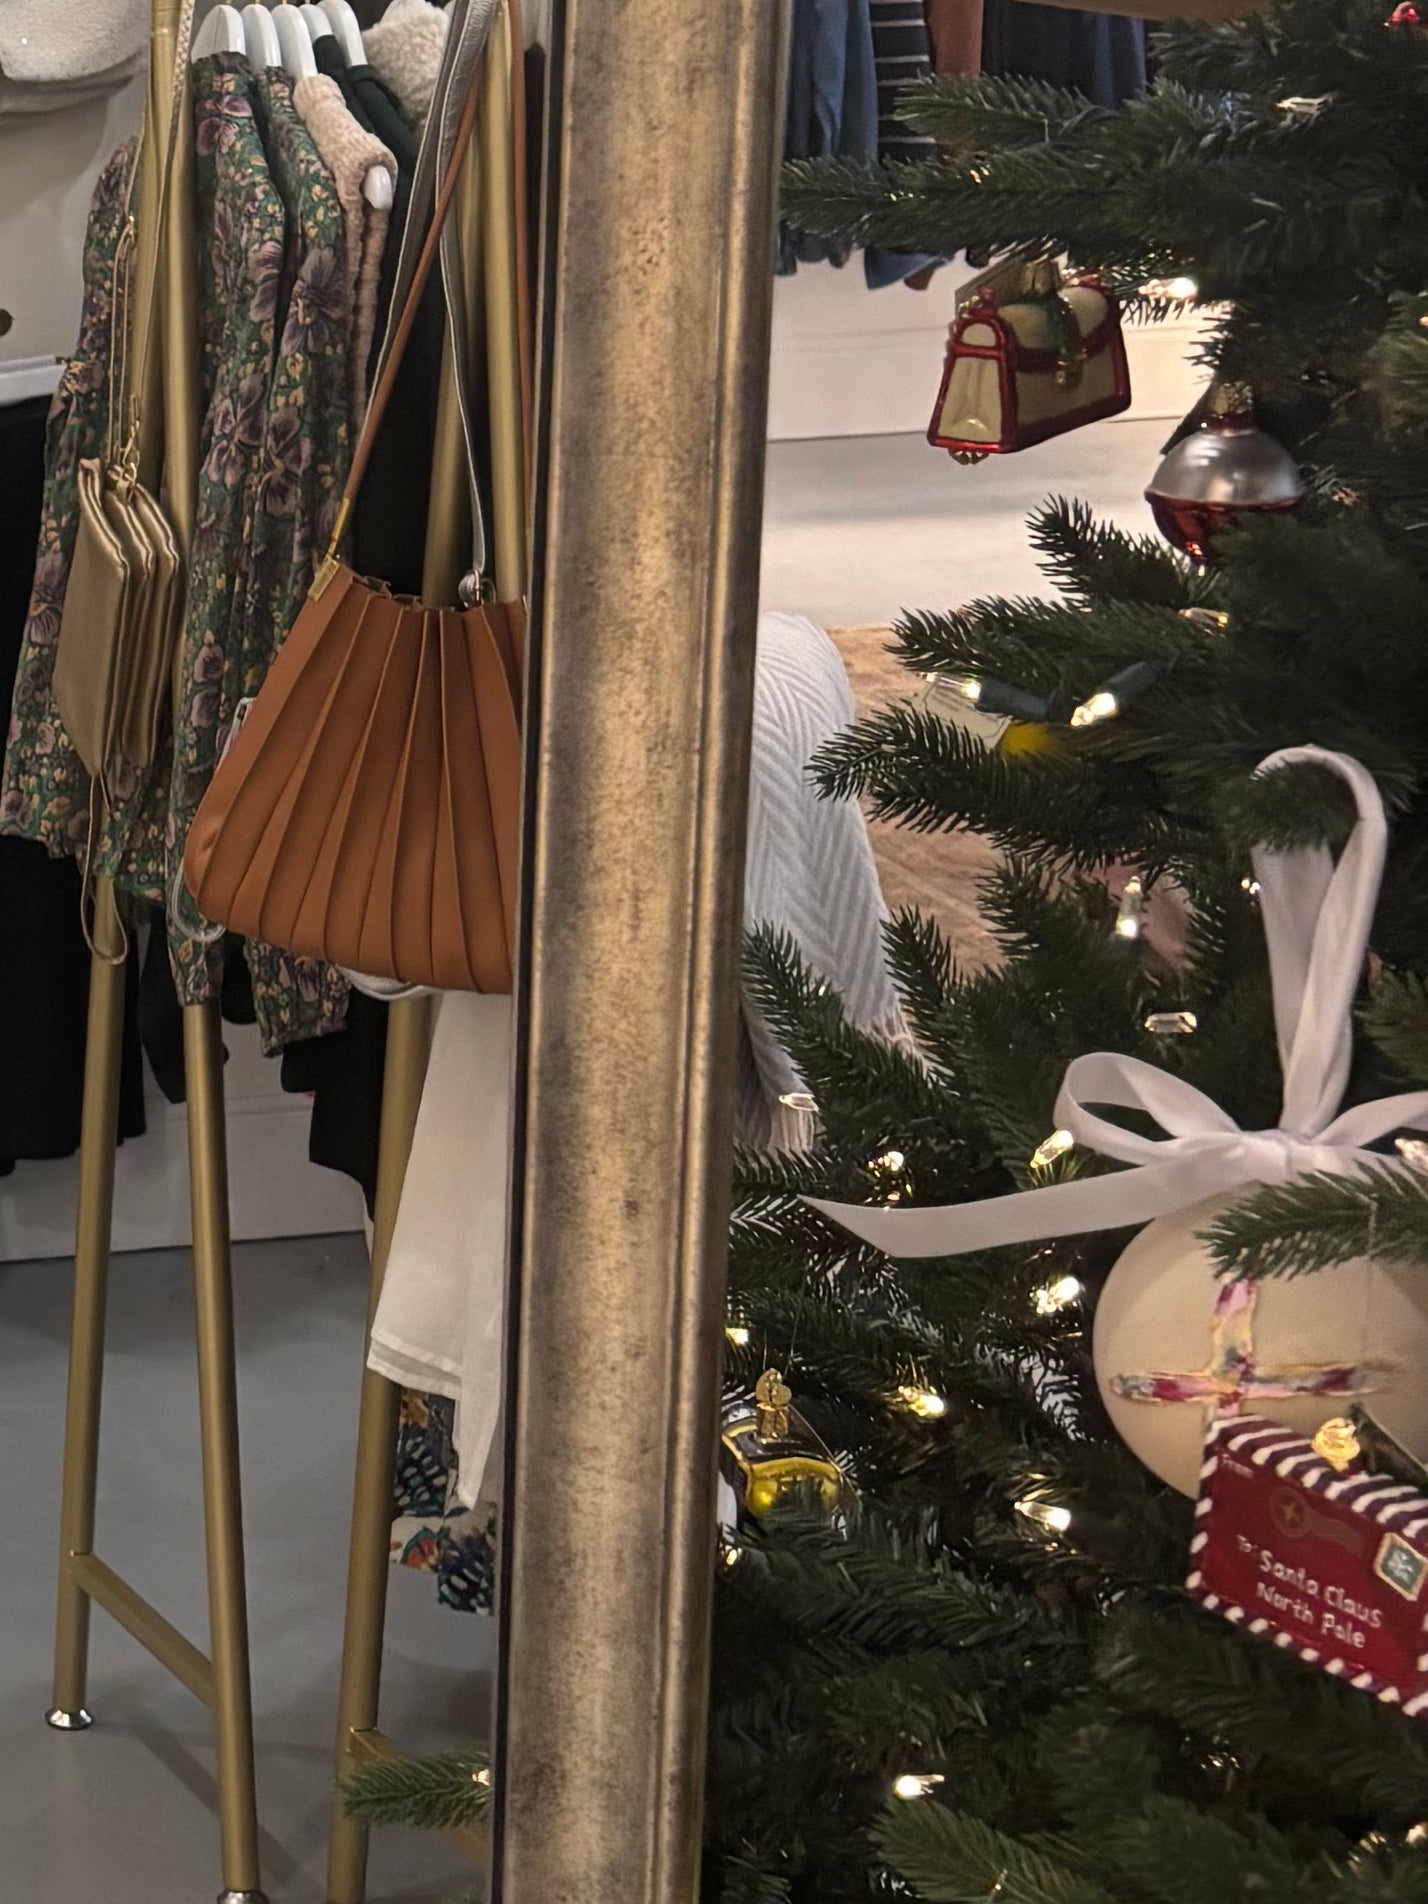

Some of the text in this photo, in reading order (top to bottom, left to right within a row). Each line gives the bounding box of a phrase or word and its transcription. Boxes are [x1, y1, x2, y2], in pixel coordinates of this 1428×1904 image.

[1256, 1582, 1314, 1623] North
[1259, 1550, 1319, 1596] Santa
[1324, 1585, 1383, 1629] Claus
